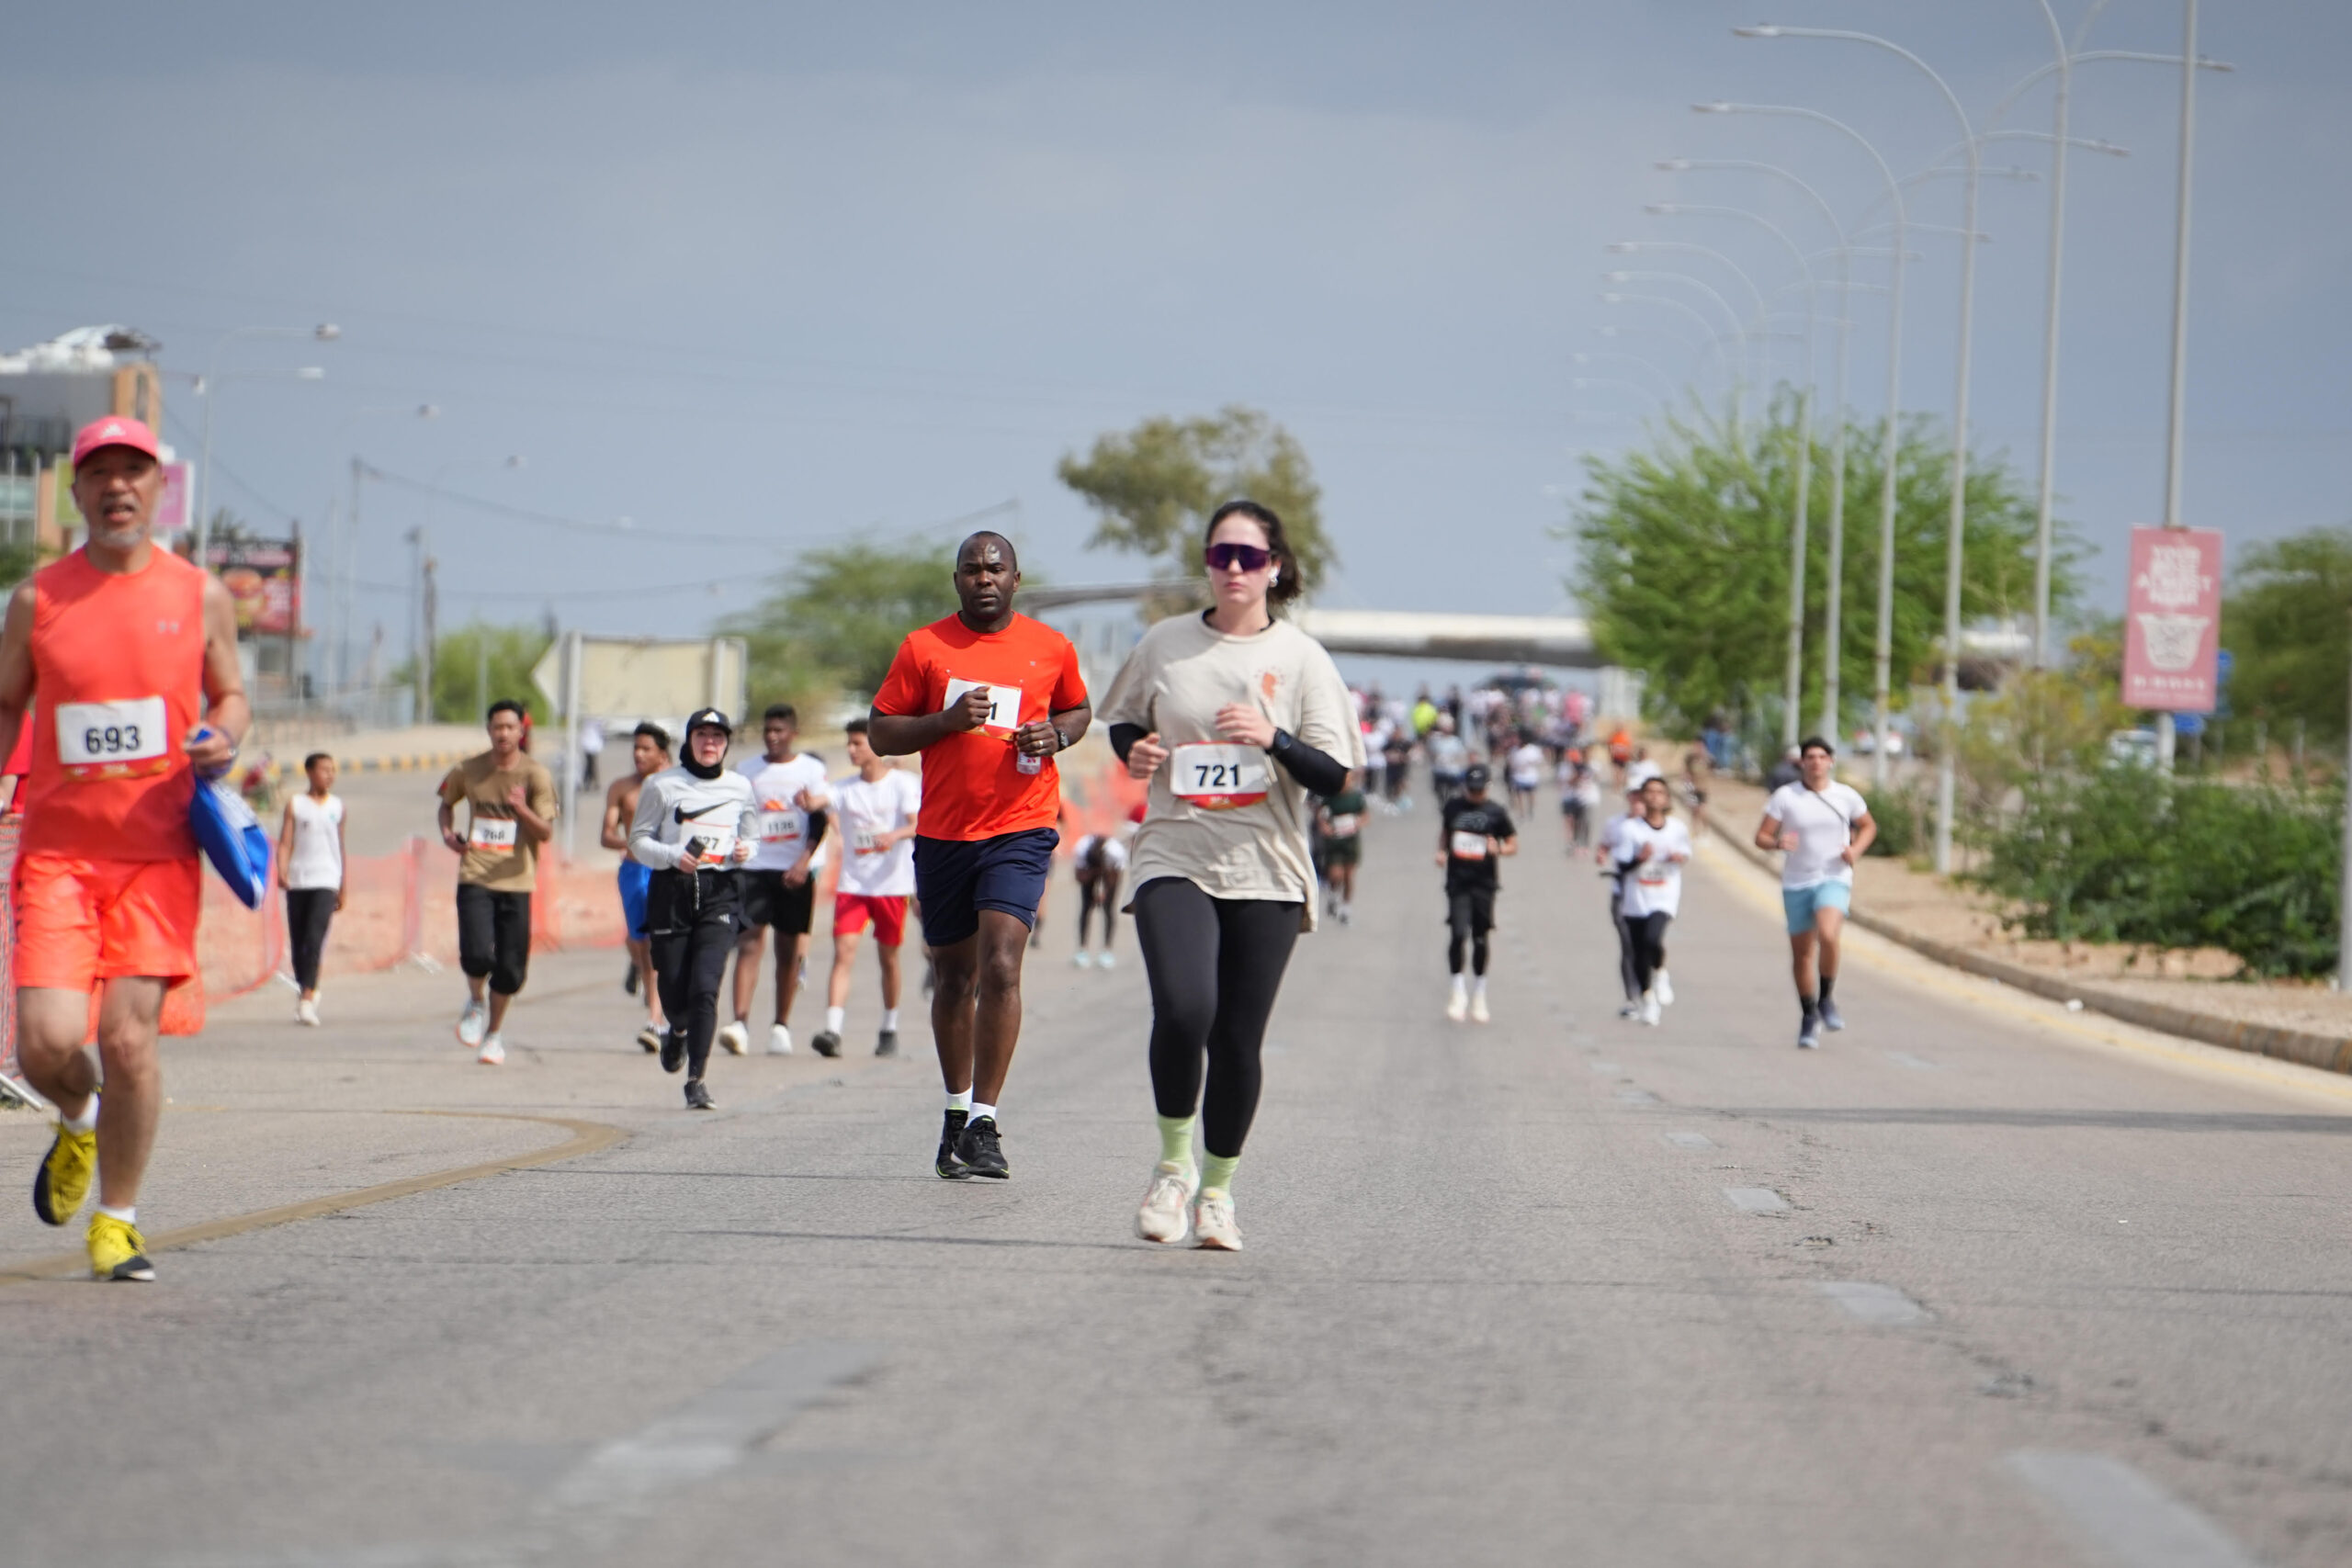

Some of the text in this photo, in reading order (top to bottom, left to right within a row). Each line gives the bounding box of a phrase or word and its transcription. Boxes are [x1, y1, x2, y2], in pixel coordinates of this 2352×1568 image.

[85, 725, 140, 754] 693
[1195, 763, 1240, 787] 721
[698, 835, 719, 851] 27
